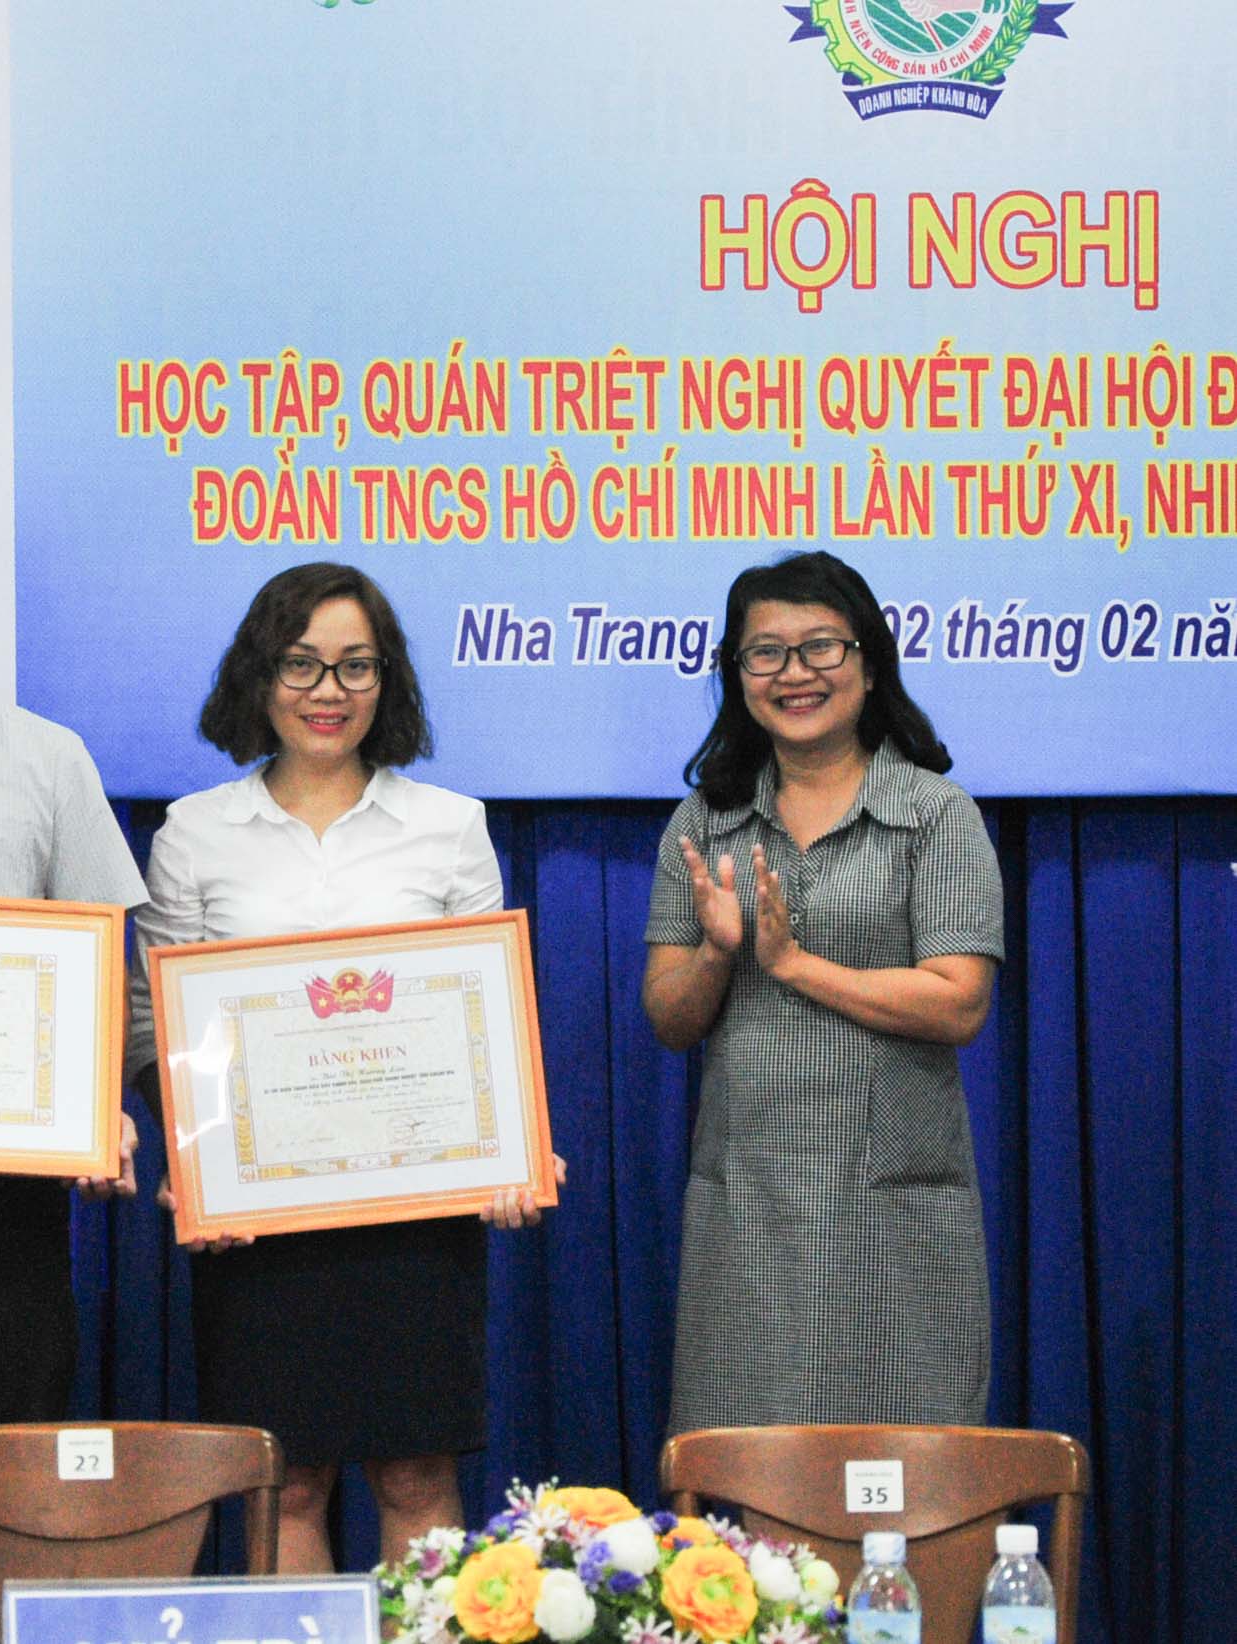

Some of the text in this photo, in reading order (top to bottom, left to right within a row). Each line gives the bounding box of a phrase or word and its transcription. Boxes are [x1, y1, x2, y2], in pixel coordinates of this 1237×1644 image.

[968, 25, 994, 54] MINH
[858, 91, 893, 116] DOANH
[893, 84, 930, 108] NGHIỆP
[966, 92, 987, 115] HÒA
[701, 178, 1159, 313] HỘI NGHỊ
[117, 360, 228, 453] HỌC
[241, 349, 348, 453] TẬP,
[362, 340, 507, 439] QUÁN
[522, 347, 666, 450] TRIỆT
[681, 357, 802, 448] NGHỊ
[818, 339, 991, 435] QUYẾT
[1002, 355, 1089, 446] ĐẠI
[1106, 343, 1193, 446] HỘI
[193, 443, 1237, 550] ĐOÀN TNCS HỒ CHÍ MINH LẦN THỨ XI, NHI
[456, 607, 552, 662] Nha
[945, 602, 1086, 674] tháng
[1100, 602, 1160, 659] 02
[1171, 601, 1237, 659] nă
[361, 1044, 408, 1062] KHEN
[860, 1486, 889, 1505] 35
